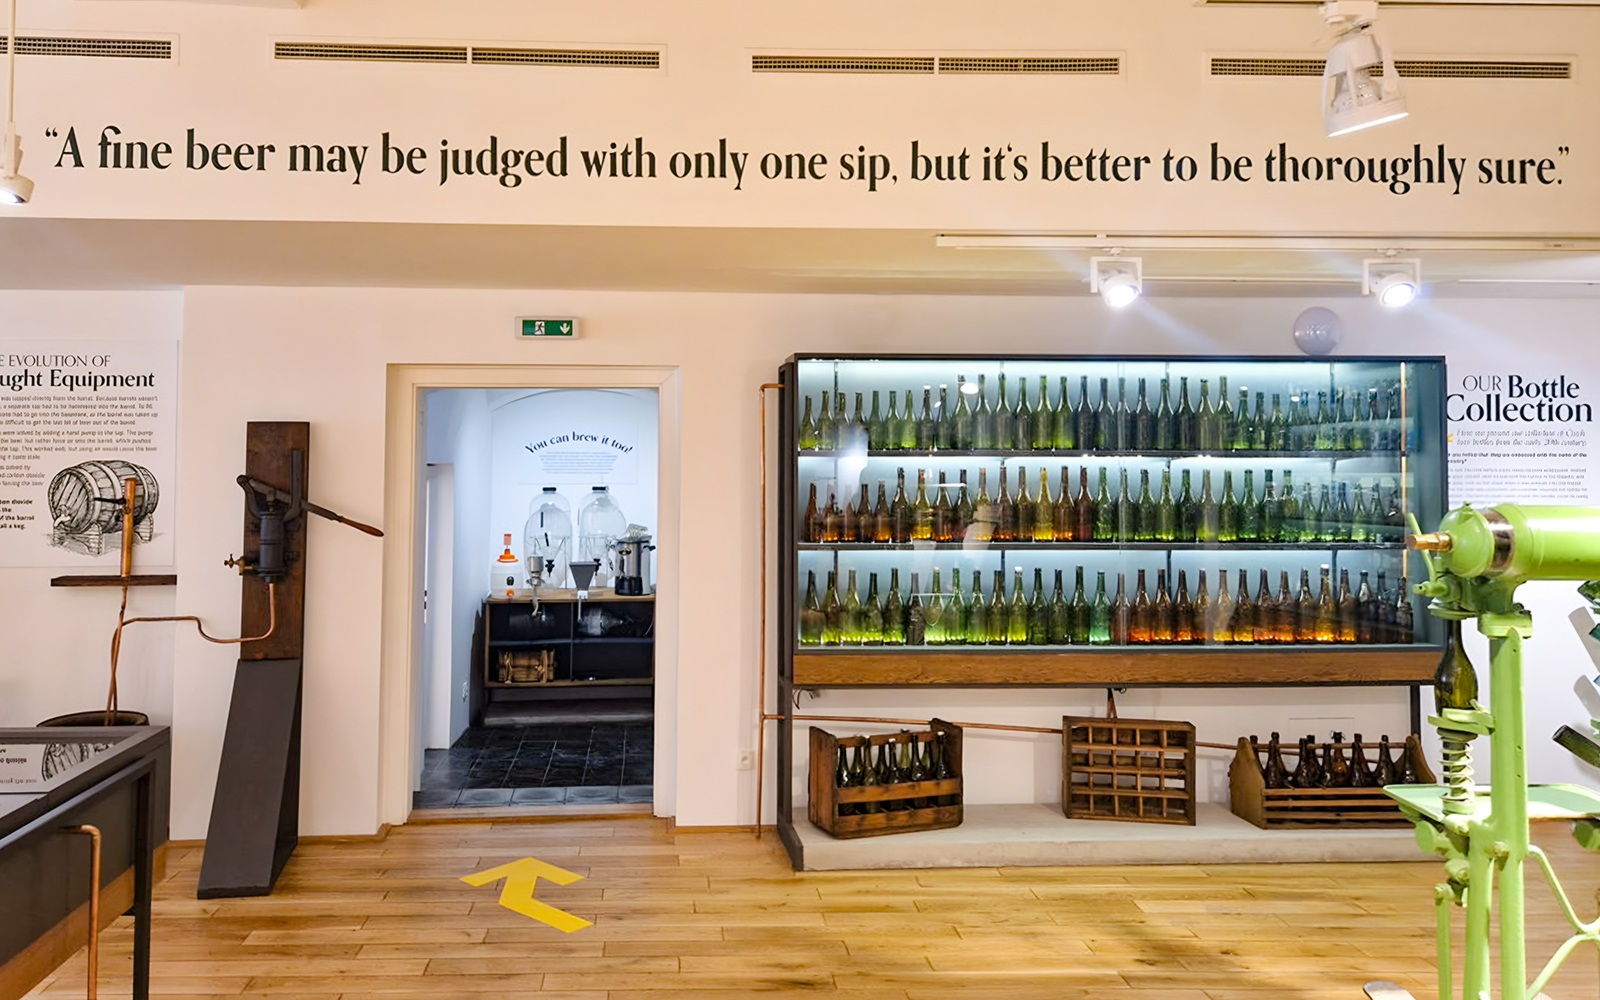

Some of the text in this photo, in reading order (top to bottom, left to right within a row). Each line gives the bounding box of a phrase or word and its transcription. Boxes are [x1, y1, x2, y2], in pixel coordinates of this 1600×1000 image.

[46, 127, 84, 168] “A
[98, 126, 172, 169] fine
[187, 129, 276, 170] beer
[289, 144, 368, 185] may
[382, 132, 427, 174] be
[440, 136, 568, 187] judged
[581, 137, 656, 178] with
[670, 139, 749, 190] only
[761, 152, 827, 180] one
[840, 145, 898, 192] sip,
[911, 141, 970, 181] but
[1042, 141, 1150, 182] better
[1163, 148, 1198, 181] to
[1211, 142, 1252, 182] be
[1265, 142, 1466, 194] thoroughly
[8, 354, 88, 367] EVOLUTION
[92, 354, 111, 367] OF
[50, 368, 155, 392] Equipment
[1463, 375, 1580, 398] OUR Bottle
[1447, 393, 1593, 422] Collection
[525, 431, 634, 455] You can brew it too!
